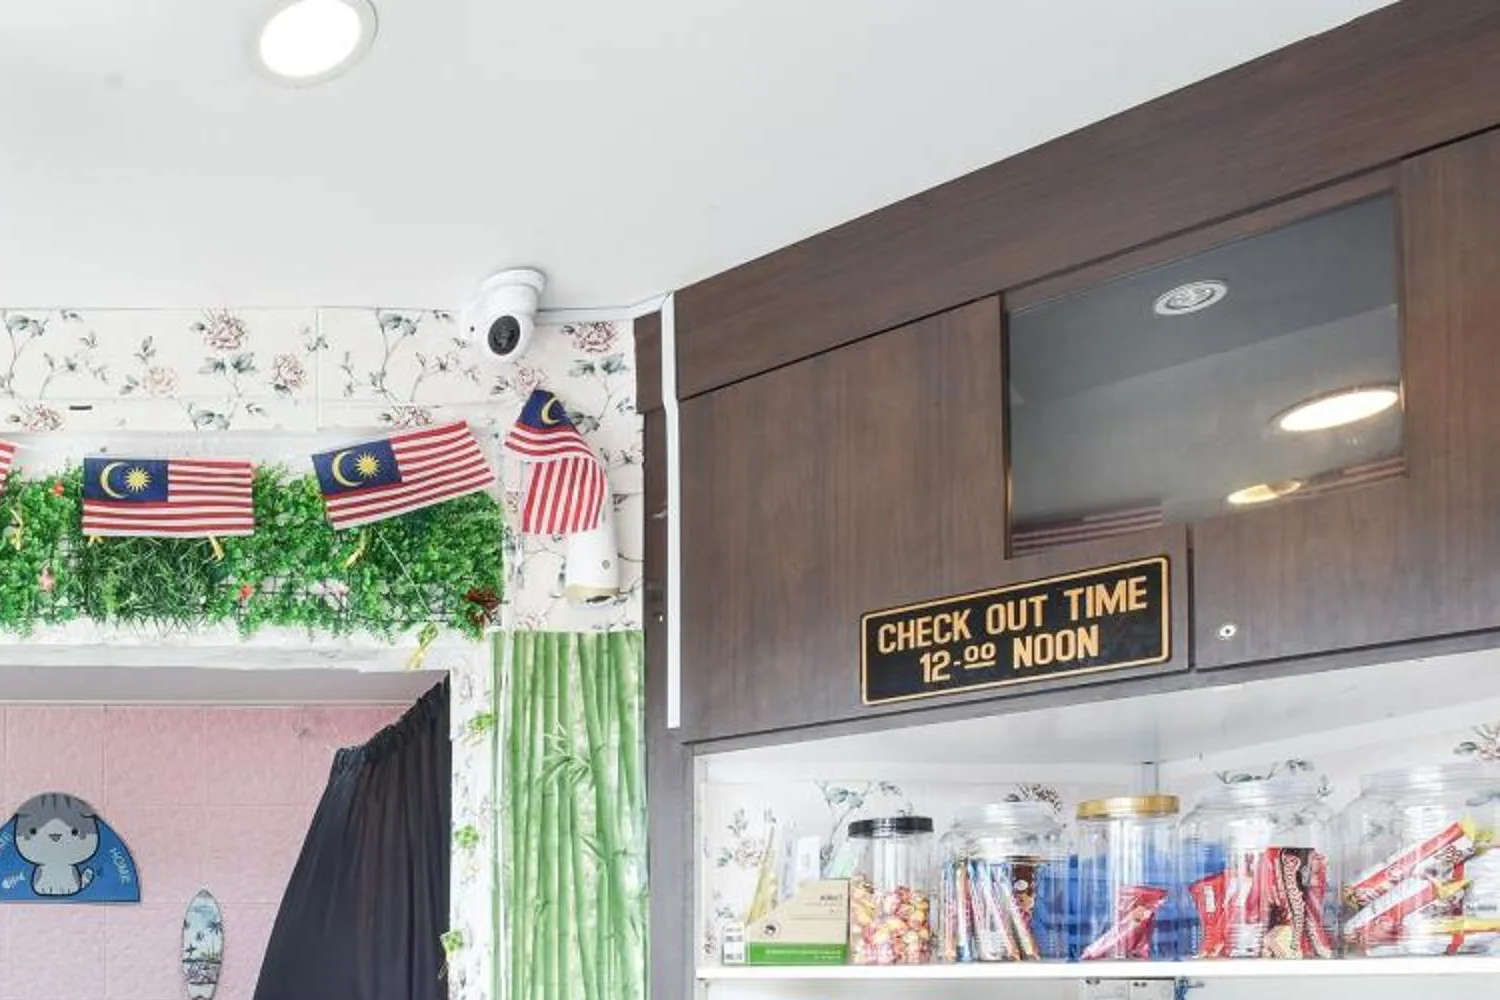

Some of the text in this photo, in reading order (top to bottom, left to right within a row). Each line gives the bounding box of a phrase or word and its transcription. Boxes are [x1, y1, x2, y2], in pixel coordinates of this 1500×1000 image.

[877, 575, 1148, 654] CHECK OUT TIME
[1012, 624, 1099, 669] NOON
[109, 847, 131, 885] HOME
